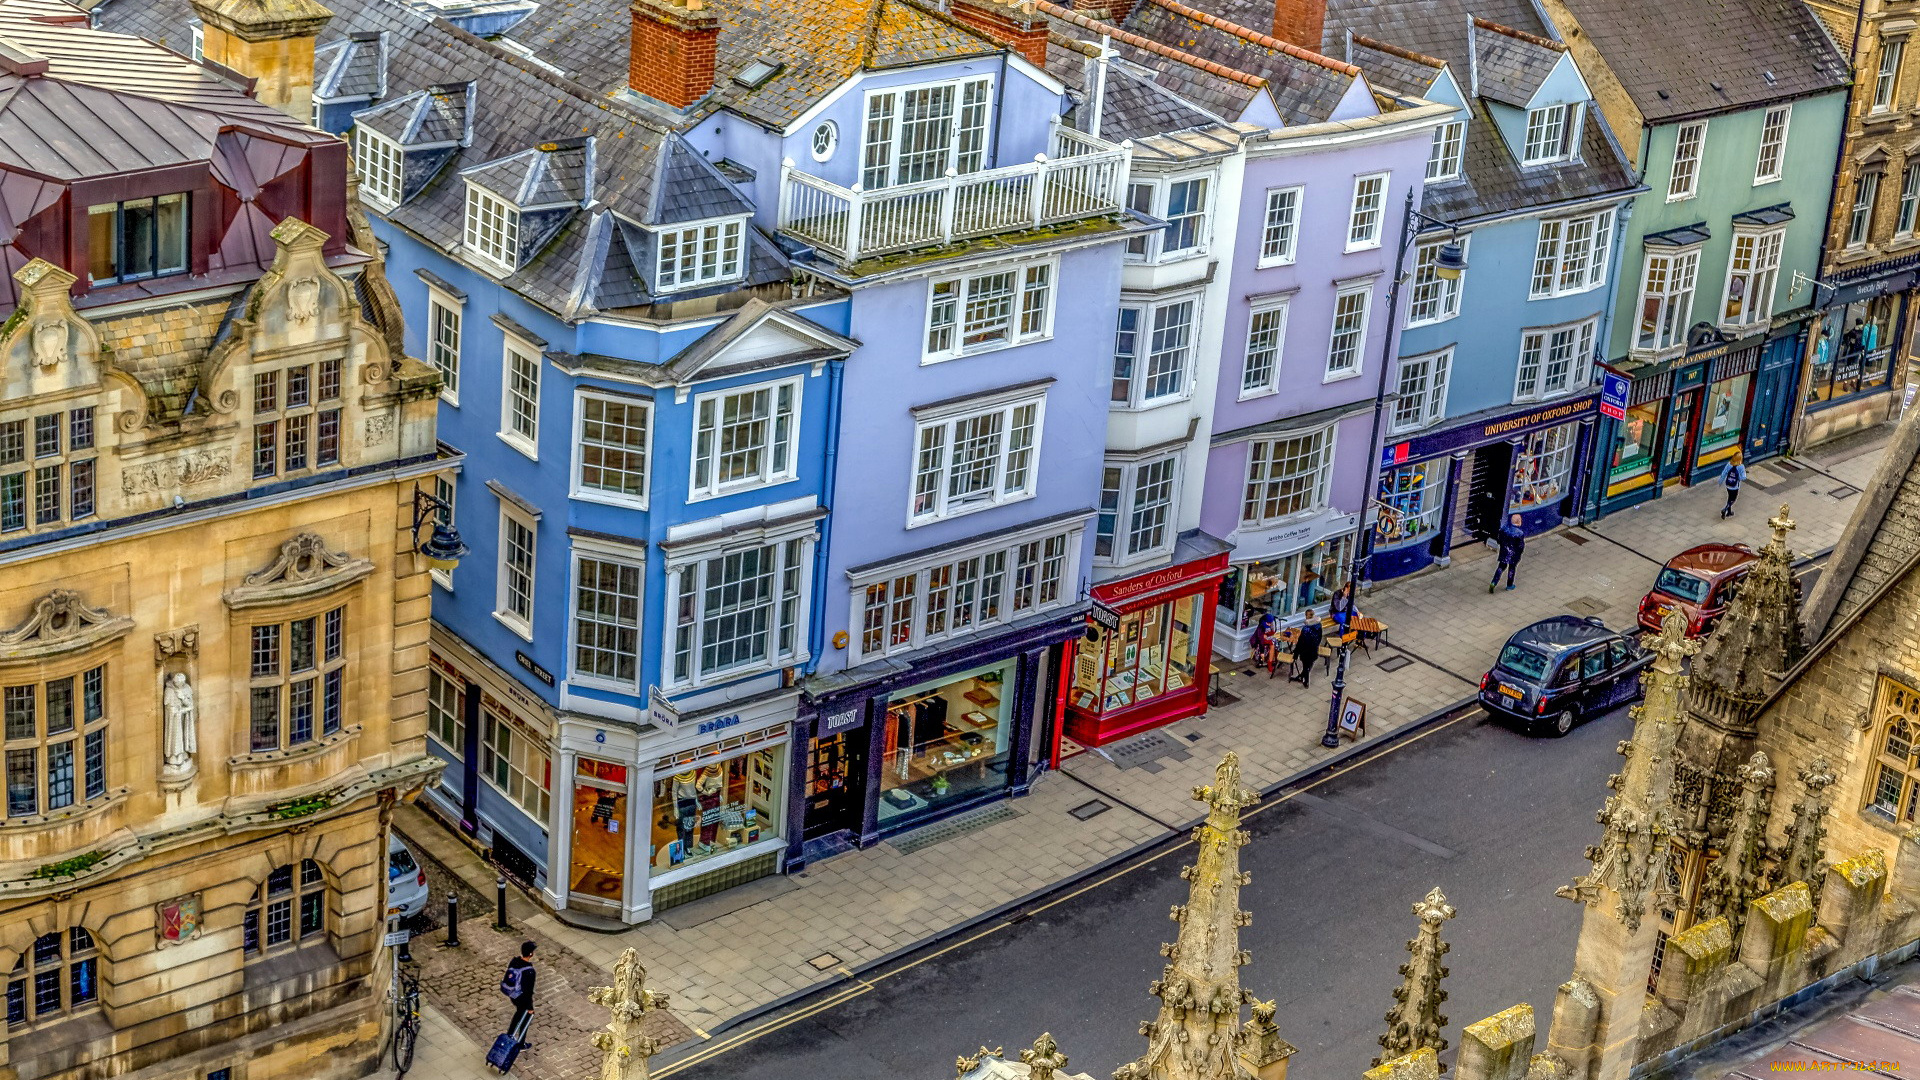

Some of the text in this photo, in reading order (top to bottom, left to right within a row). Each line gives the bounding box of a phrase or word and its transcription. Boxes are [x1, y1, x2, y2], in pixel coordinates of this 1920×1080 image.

[1602, 405, 1623, 417] SHOP
[1603, 395, 1624, 407] OXFORD
[1484, 399, 1593, 436] UNIVERSITY OF OXFORD SHOP
[1283, 531, 1298, 539] Coffee
[1112, 568, 1183, 597] Sanders of Oxford
[1092, 604, 1119, 629] TOAST
[518, 654, 552, 684] ORIEL STREET
[827, 708, 858, 730] TOAST
